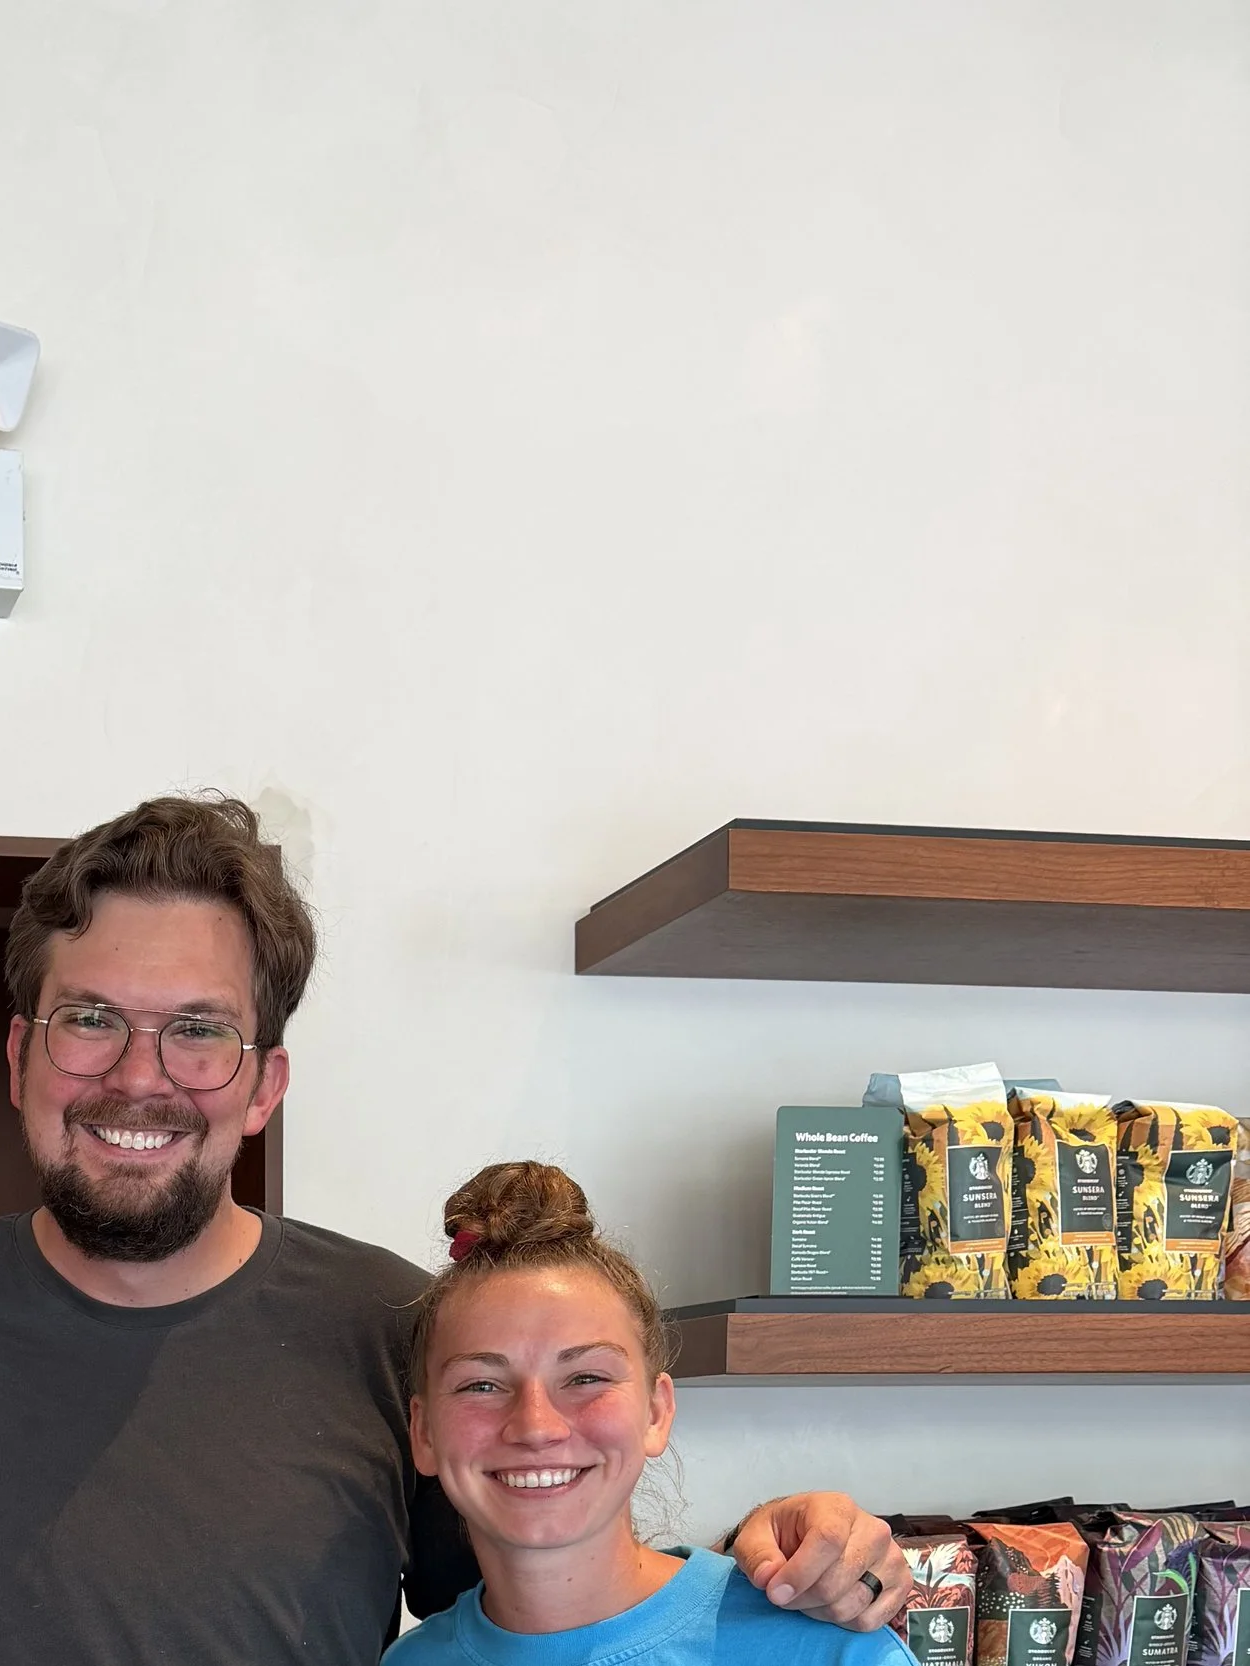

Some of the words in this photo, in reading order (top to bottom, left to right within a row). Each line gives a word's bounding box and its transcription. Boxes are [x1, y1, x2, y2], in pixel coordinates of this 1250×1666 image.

[795, 1132, 825, 1142] Whole
[825, 1133, 848, 1142] Bean
[849, 1133, 879, 1142] Coffee
[963, 1192, 997, 1202] SUNSERA
[1179, 1194, 1219, 1202] SUNSERA
[1142, 1647, 1178, 1656] SUMATRA
